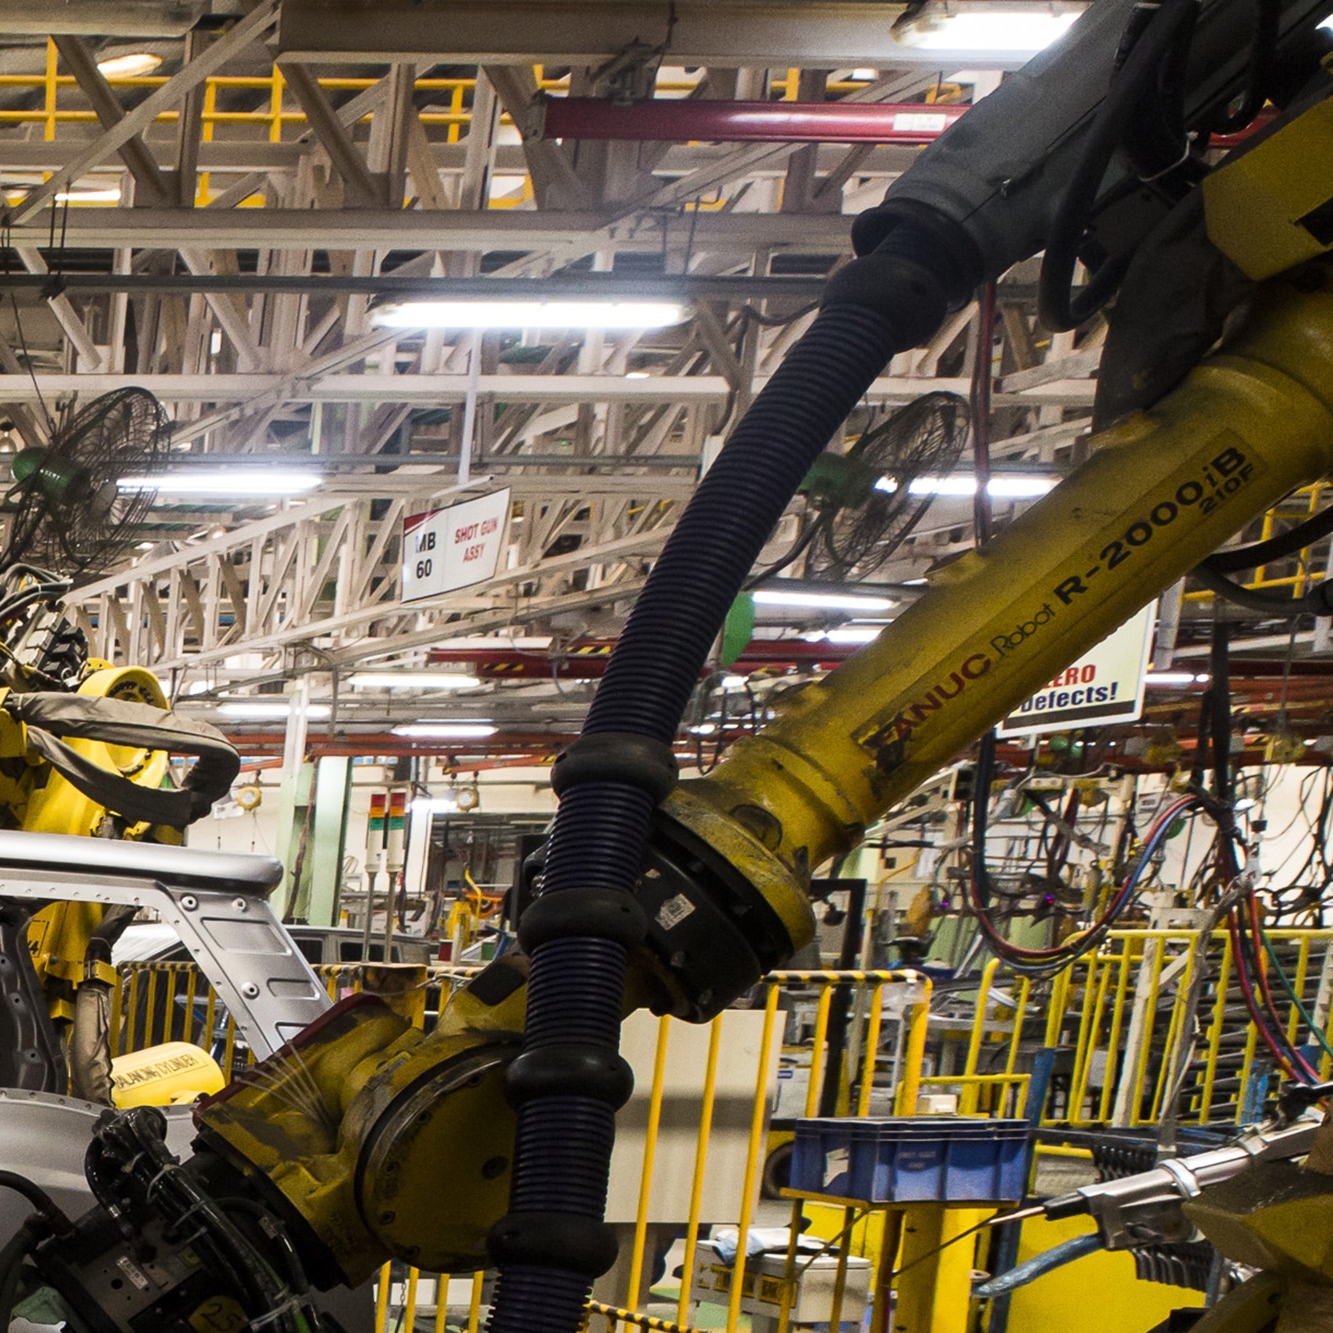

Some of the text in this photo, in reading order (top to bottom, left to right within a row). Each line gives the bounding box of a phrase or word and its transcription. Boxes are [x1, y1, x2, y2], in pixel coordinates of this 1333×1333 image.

[1199, 463, 1255, 514] 210F
[454, 523, 480, 545] SHOT
[462, 542, 486, 563] ASSY
[990, 603, 1056, 657] Robot
[1054, 446, 1247, 605] R-2000iB
[416, 558, 433, 579] 60
[1044, 664, 1096, 689] ERO
[158, 1052, 200, 1075] CYLINDER
